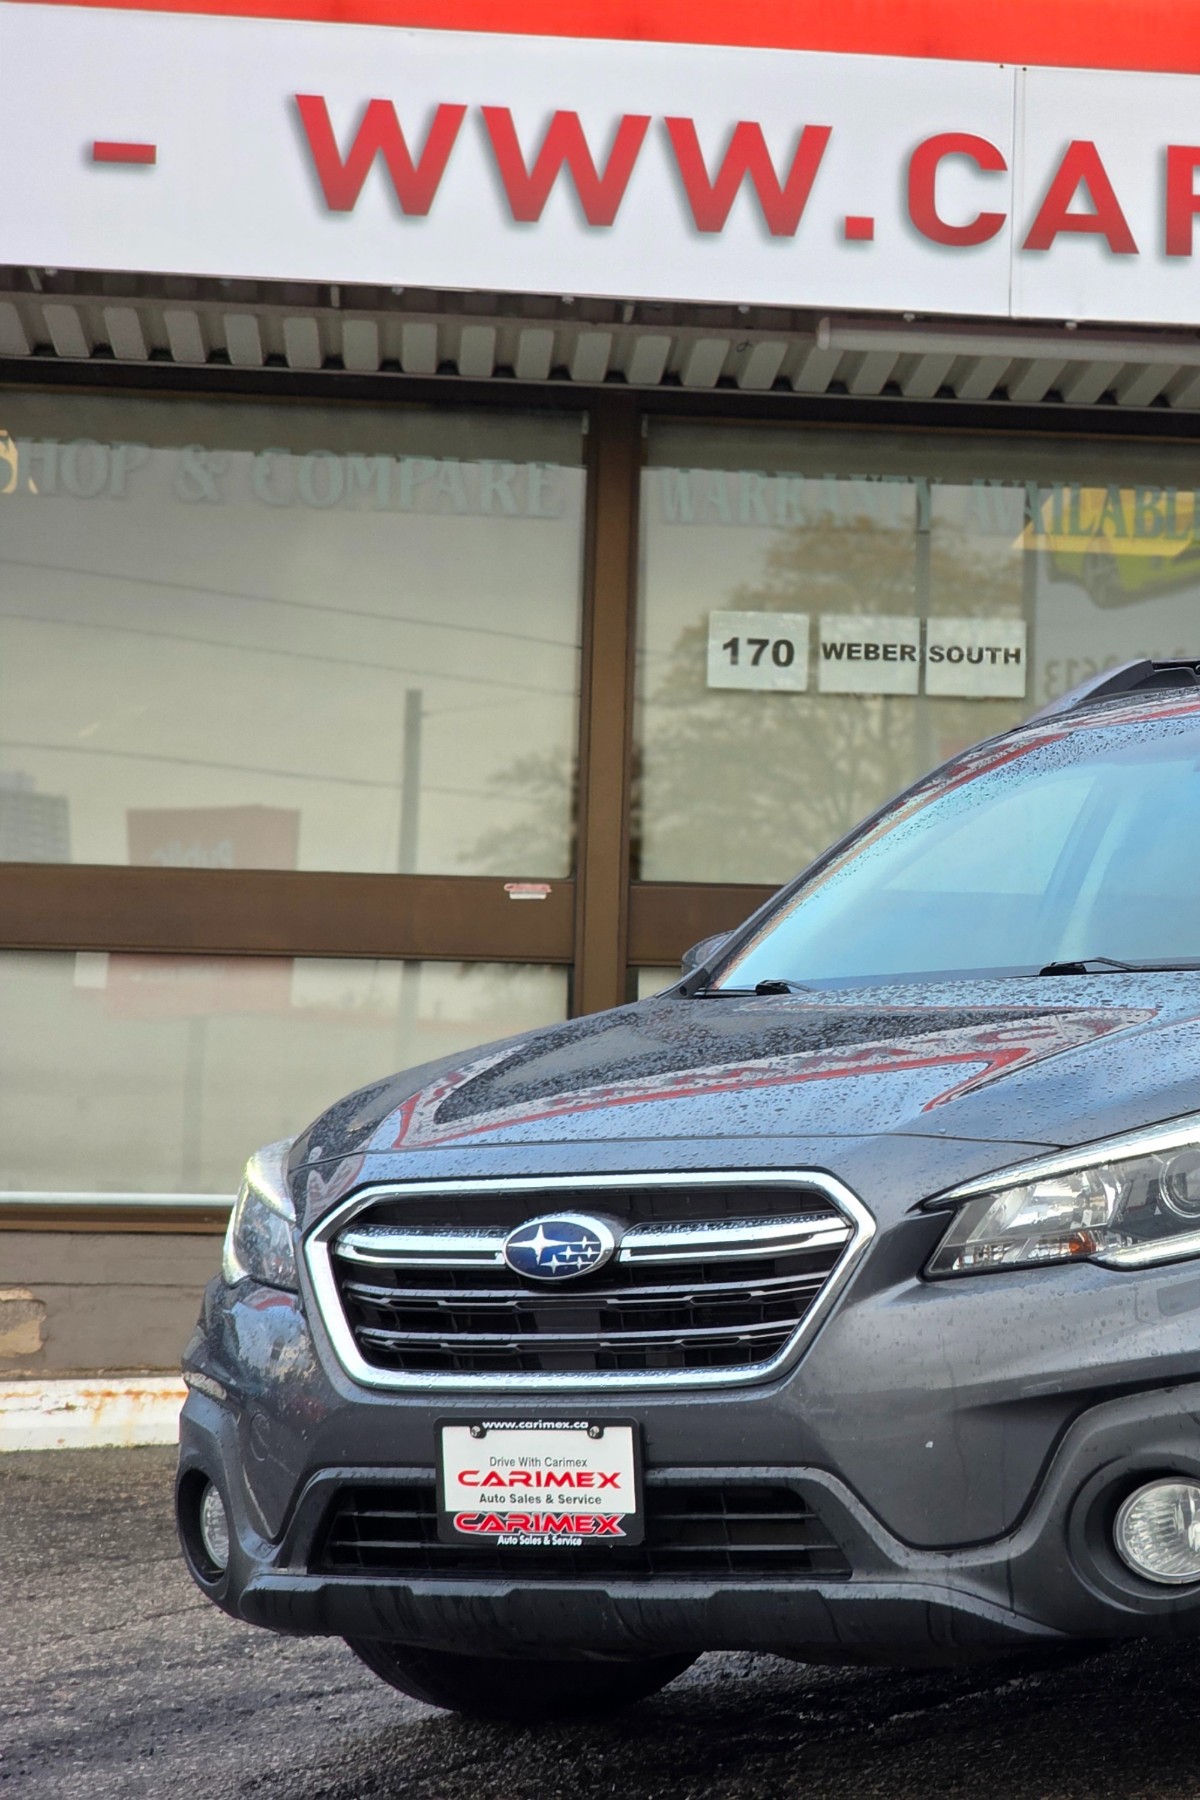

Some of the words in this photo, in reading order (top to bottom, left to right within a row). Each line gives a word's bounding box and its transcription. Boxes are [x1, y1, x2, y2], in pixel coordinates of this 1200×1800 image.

[252, 447, 560, 517] COMPARE
[722, 637, 796, 668] 170
[821, 642, 917, 662] WEBER
[928, 645, 1022, 665] SOUTH
[481, 1419, 589, 1430] www.carimex.ca
[489, 1456, 516, 1468] Drive
[518, 1457, 542, 1468] With
[544, 1457, 588, 1468] Carimex
[457, 1470, 622, 1489] CARIMEX
[479, 1493, 506, 1505] Auto
[510, 1494, 542, 1505] Sales
[545, 1494, 554, 1505] &
[558, 1494, 602, 1505] Service
[454, 1512, 624, 1536] CARIMEX
[497, 1535, 518, 1546] Auto
[519, 1535, 542, 1546] Sales
[543, 1536, 551, 1546] &
[552, 1536, 583, 1547] Service
